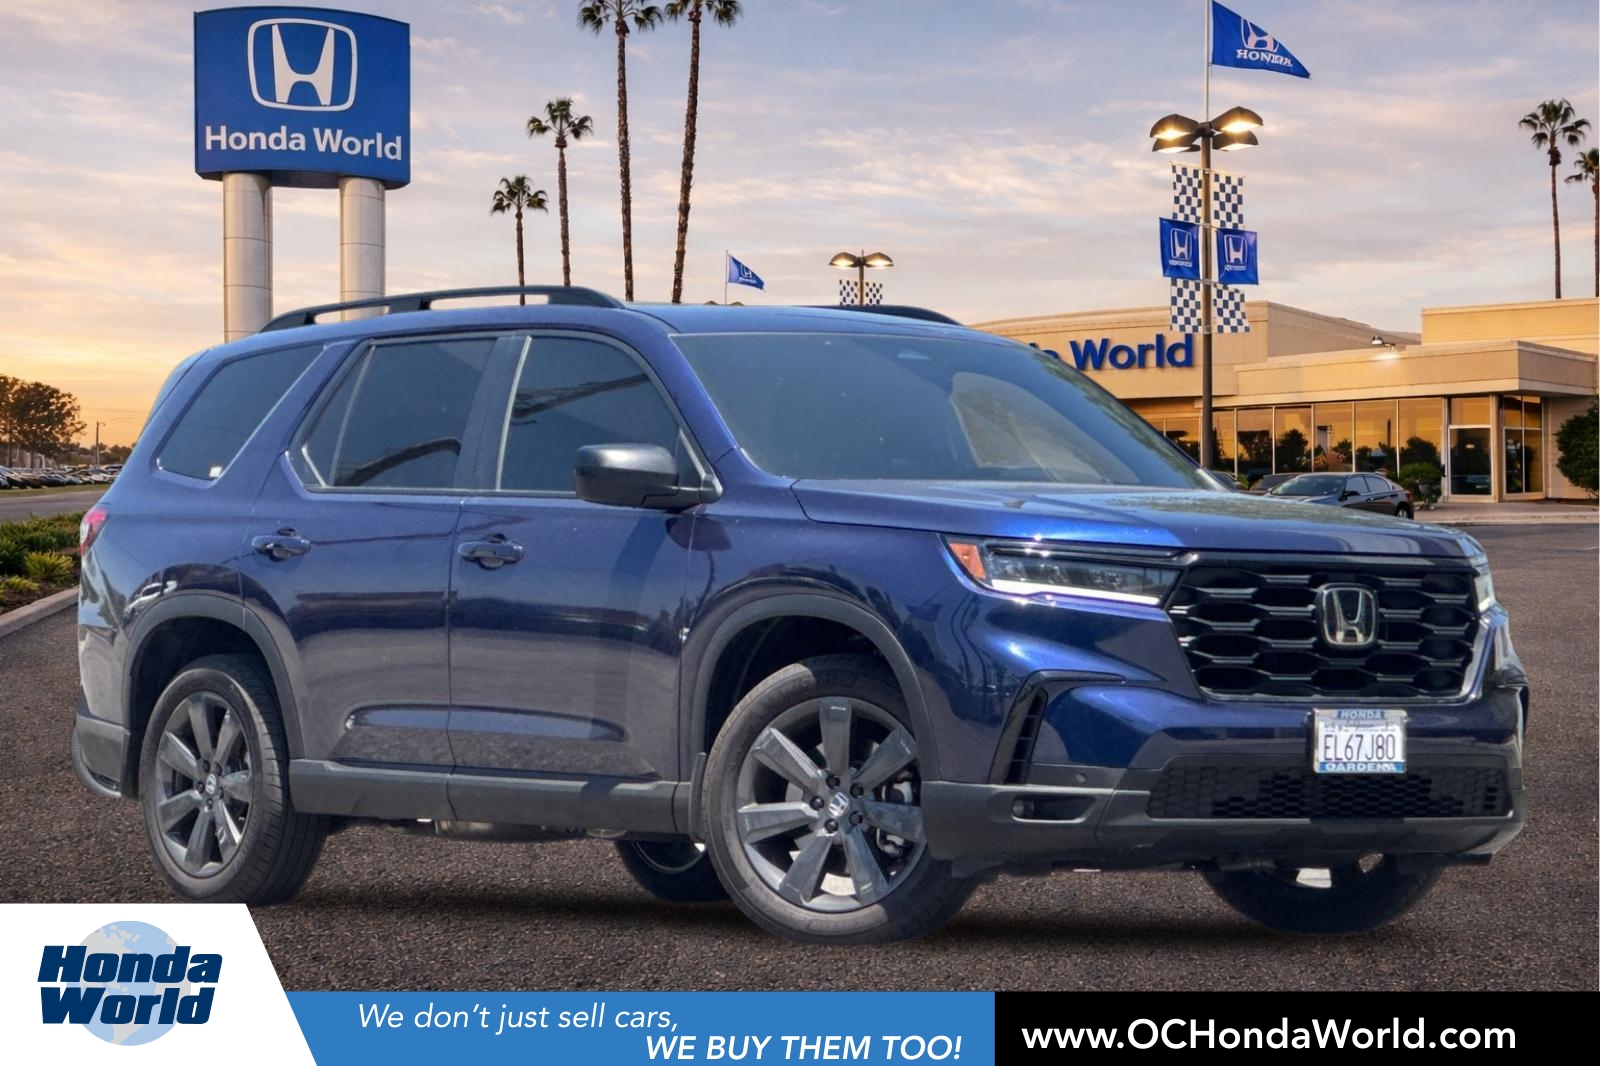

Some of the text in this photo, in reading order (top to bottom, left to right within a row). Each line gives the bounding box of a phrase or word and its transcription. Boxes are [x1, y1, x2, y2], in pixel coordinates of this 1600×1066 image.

[204, 124, 402, 160] Honda World
[1069, 333, 1193, 371] World
[1340, 709, 1382, 720] HONDA
[1324, 733, 1396, 761] EL67J80
